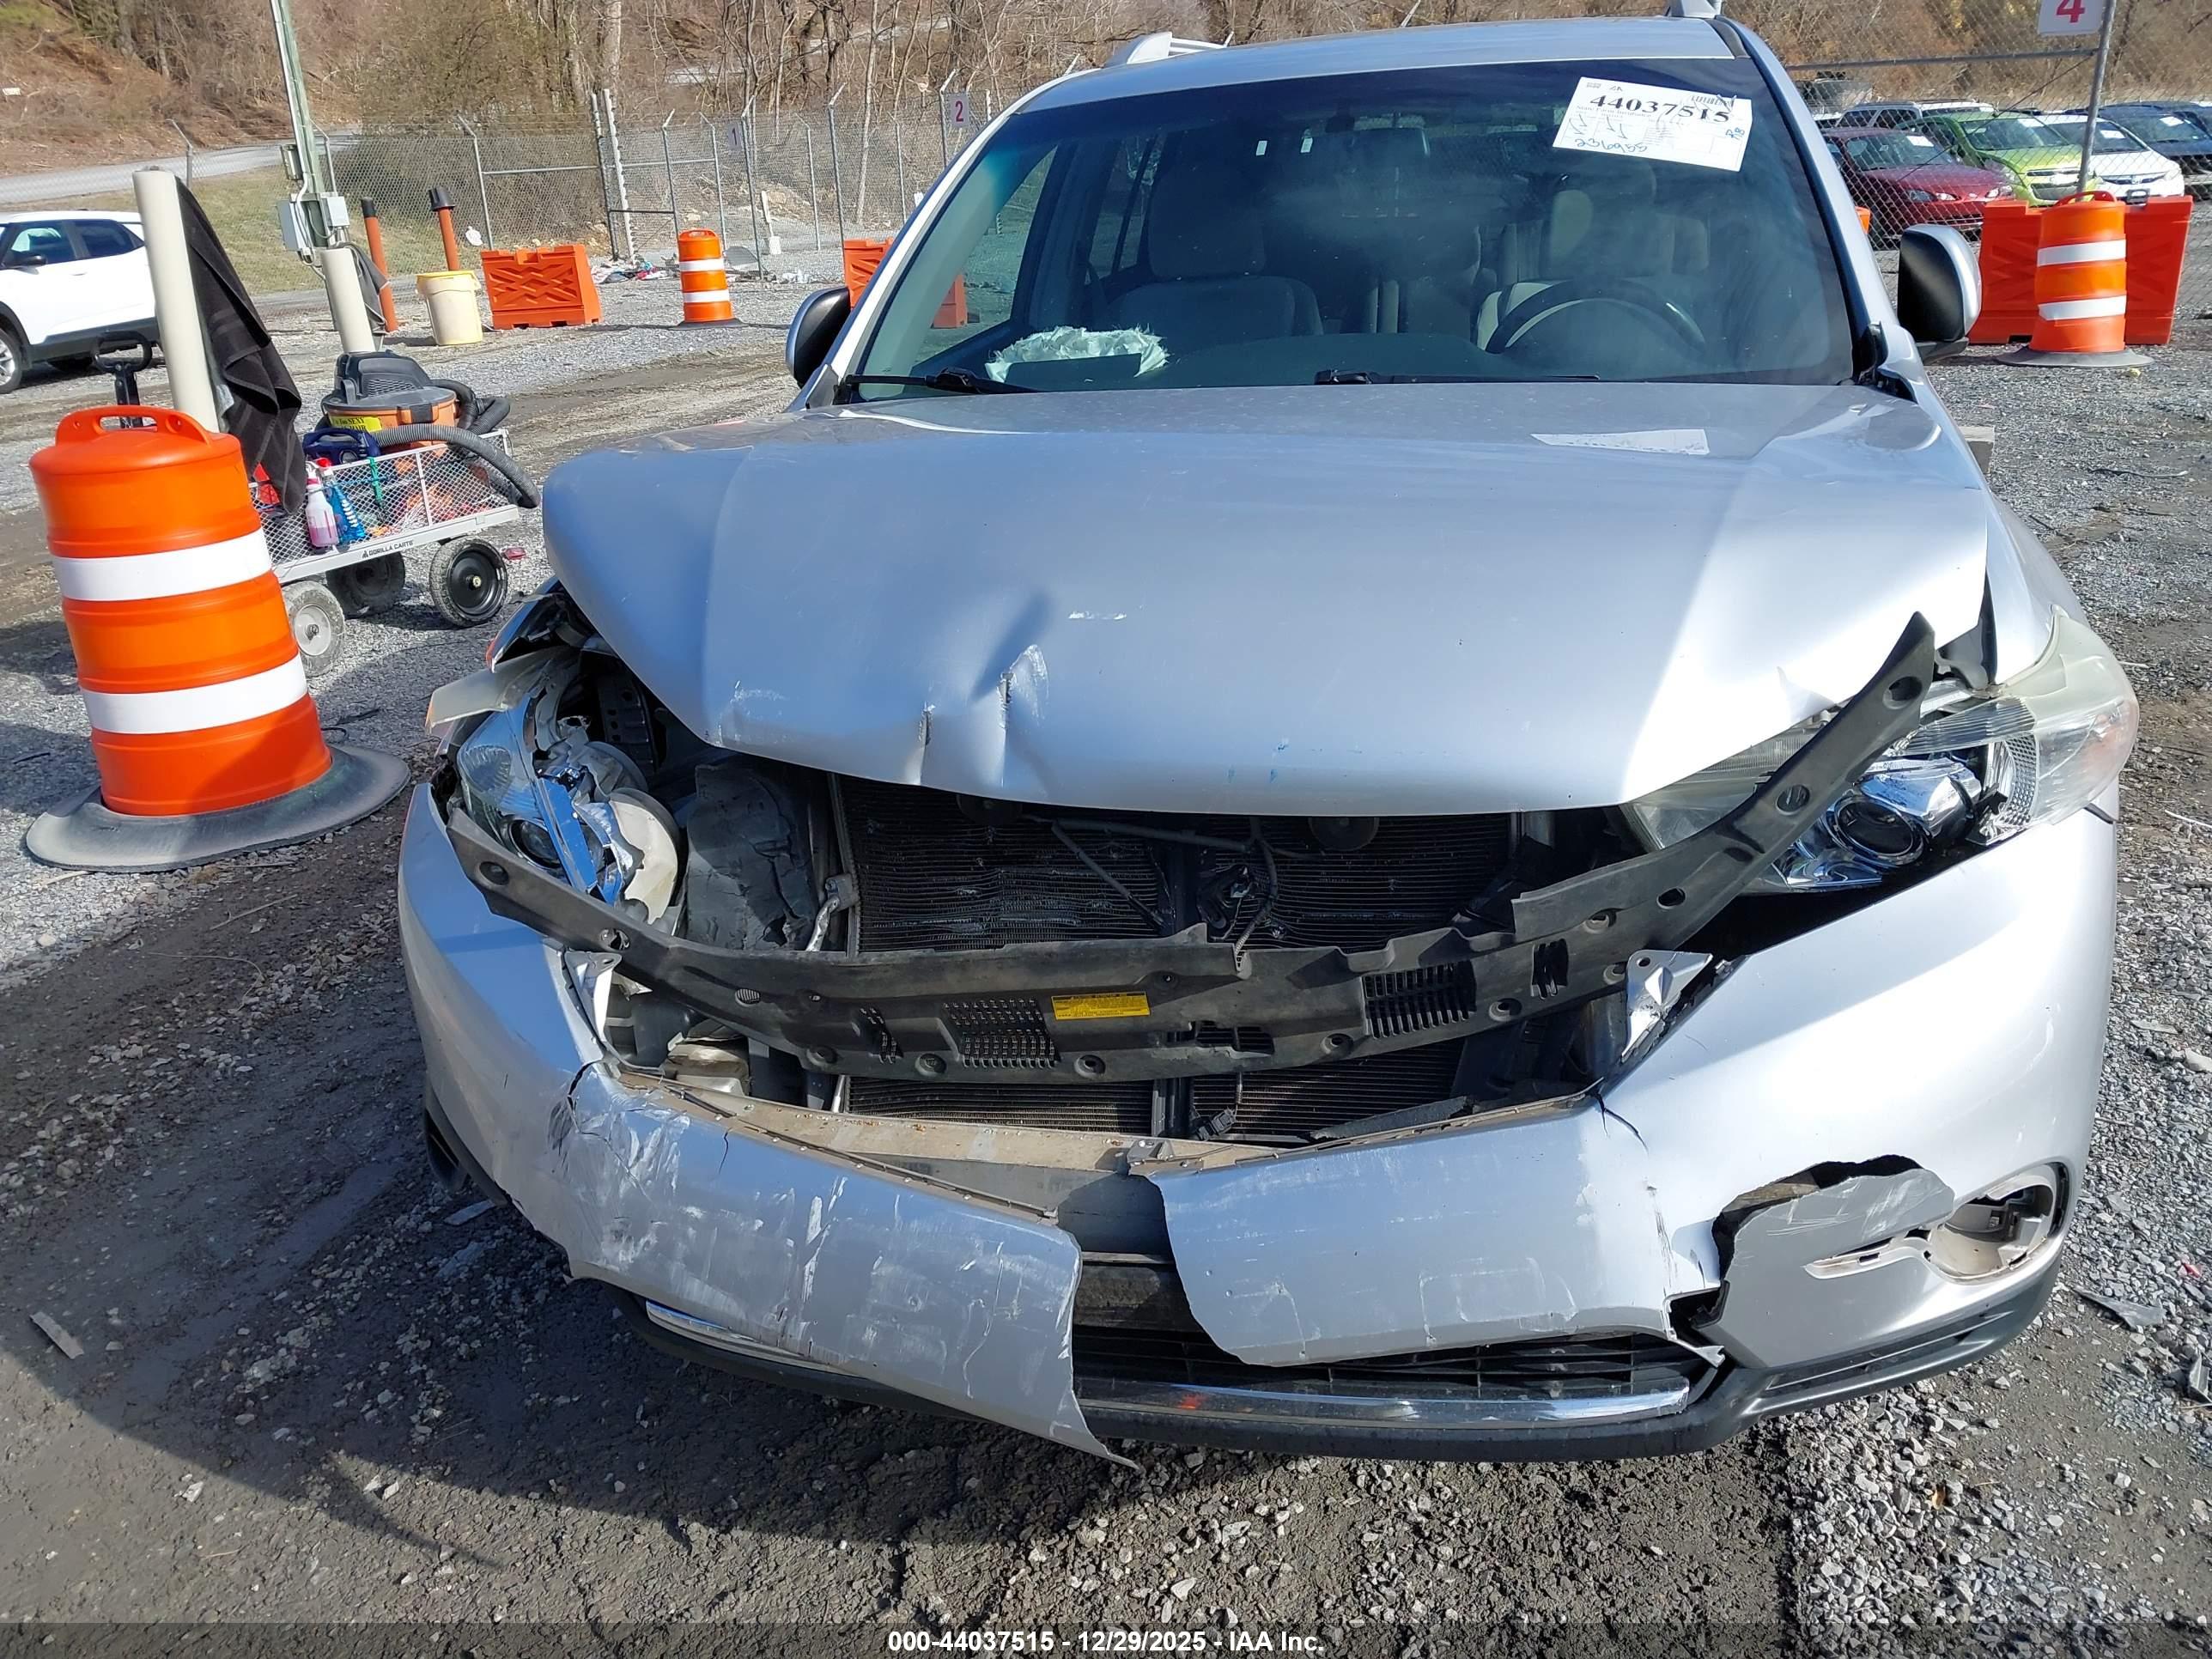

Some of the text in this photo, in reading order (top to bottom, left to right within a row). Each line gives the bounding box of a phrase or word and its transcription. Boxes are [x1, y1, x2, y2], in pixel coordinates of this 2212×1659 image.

[2056, 0, 2086, 23] 4
[955, 100, 964, 123] 2
[1589, 94, 1730, 122] 44037515
[732, 127, 738, 146] 1
[348, 416, 365, 425] SEXY
[369, 546, 393, 556] GORILLA
